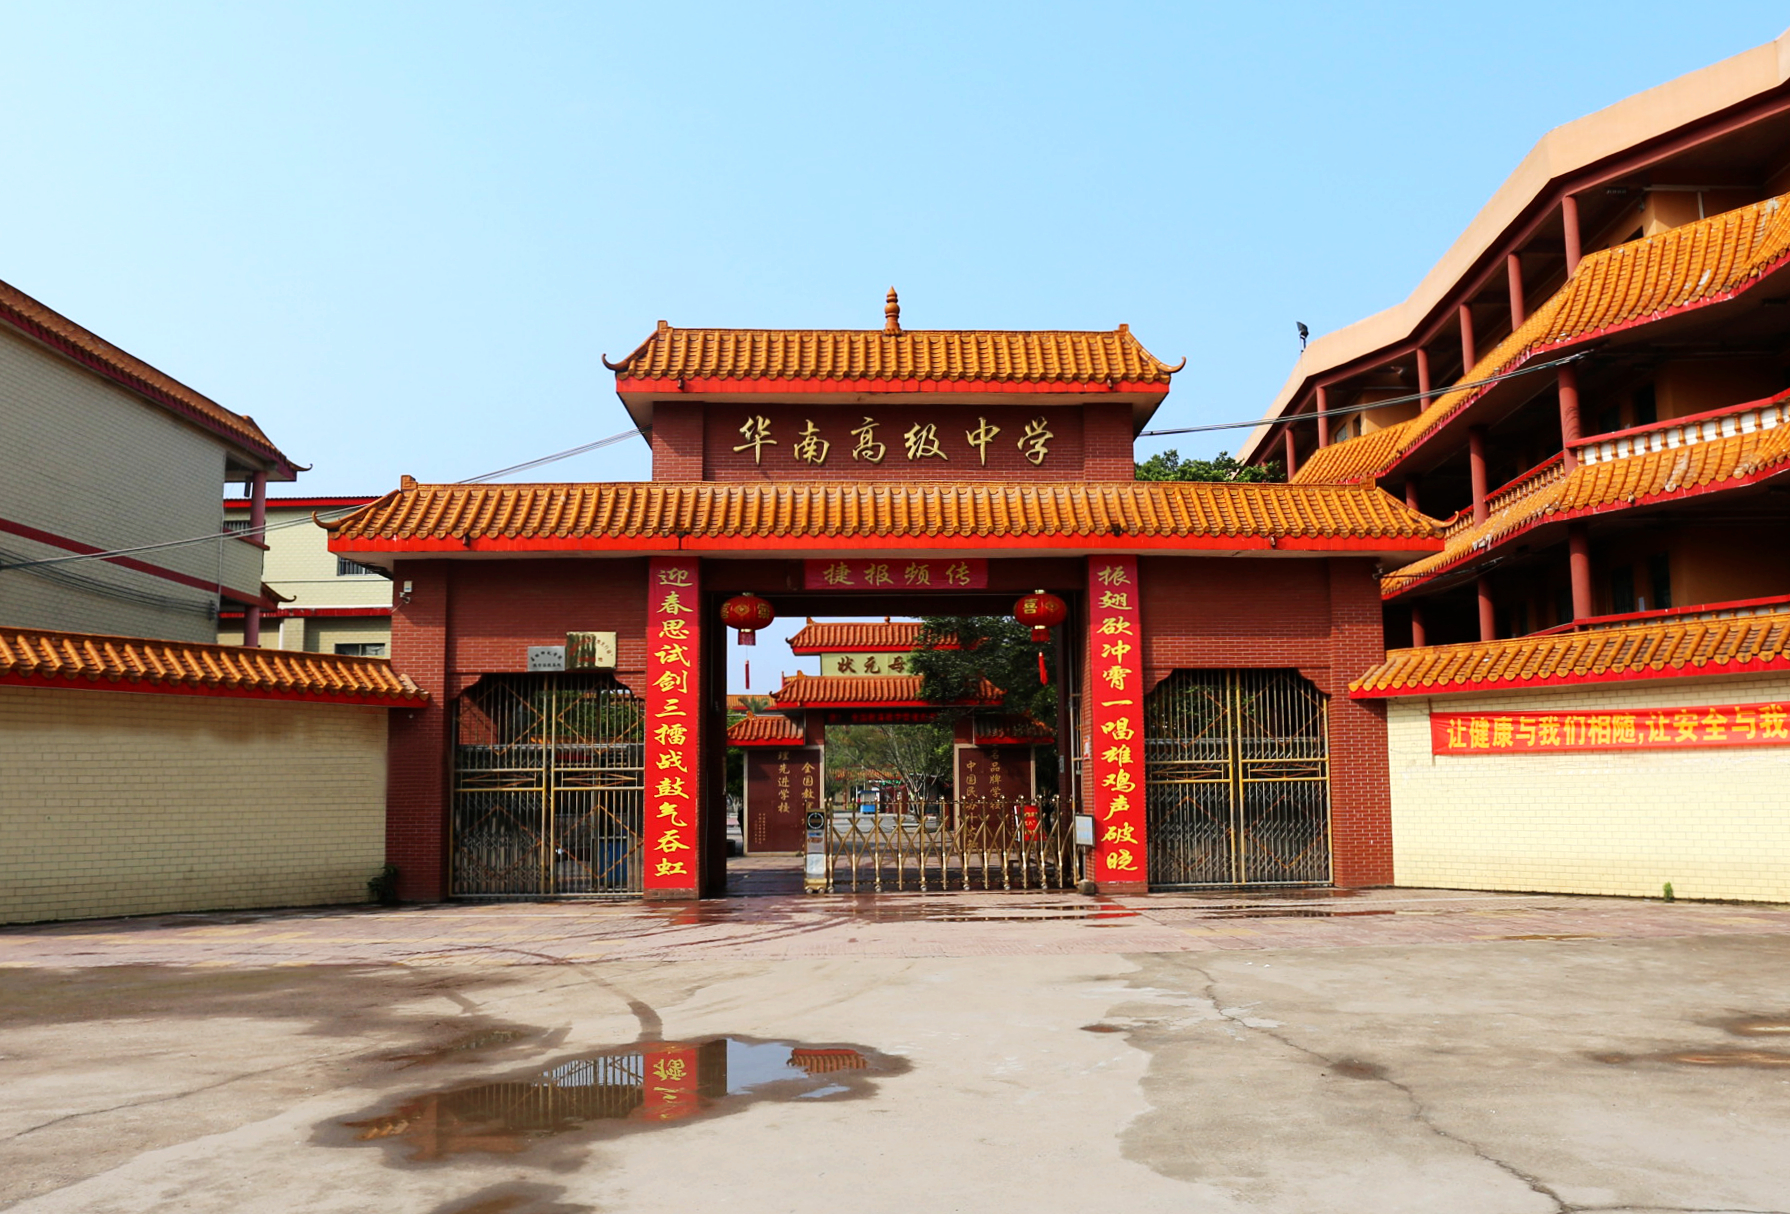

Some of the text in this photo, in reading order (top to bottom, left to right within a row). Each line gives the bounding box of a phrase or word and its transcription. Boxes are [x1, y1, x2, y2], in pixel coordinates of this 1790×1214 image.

[733, 415, 1054, 466] 华南高级中学
[822, 561, 971, 586] 捷报频传
[652, 567, 694, 877] 迎春思试剑三擂战鼓气吞虹
[1096, 565, 1138, 871] 振翅欲冲霄一唱雄鸡声破晓
